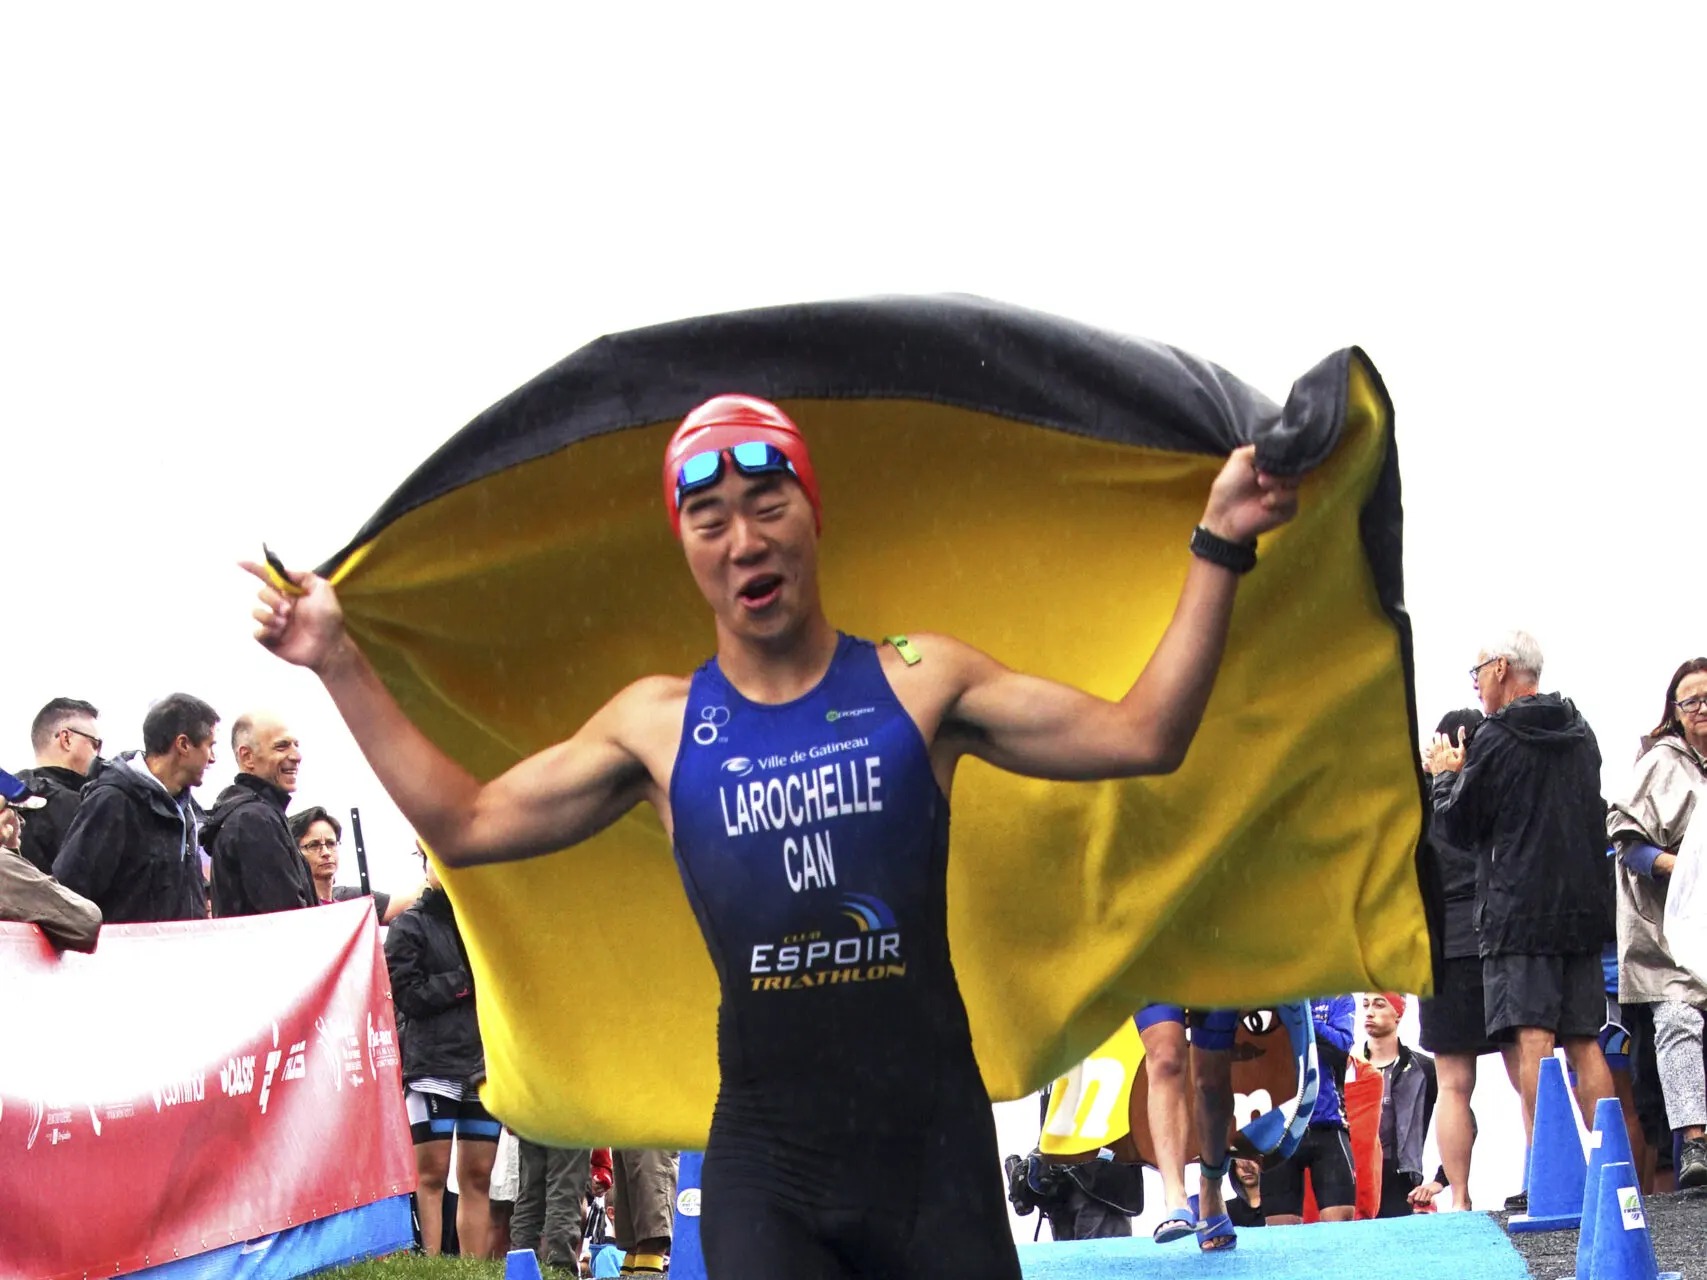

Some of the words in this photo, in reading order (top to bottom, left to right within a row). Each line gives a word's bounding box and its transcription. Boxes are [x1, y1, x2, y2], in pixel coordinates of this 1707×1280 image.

[758, 755, 787, 770] Ville
[790, 749, 806, 764] de
[809, 737, 869, 758] Gatineau
[719, 756, 883, 837] LAROCHELLE
[783, 830, 836, 893] CAN
[750, 933, 900, 973] ESPOIR
[751, 962, 907, 991] TRIATHLON
